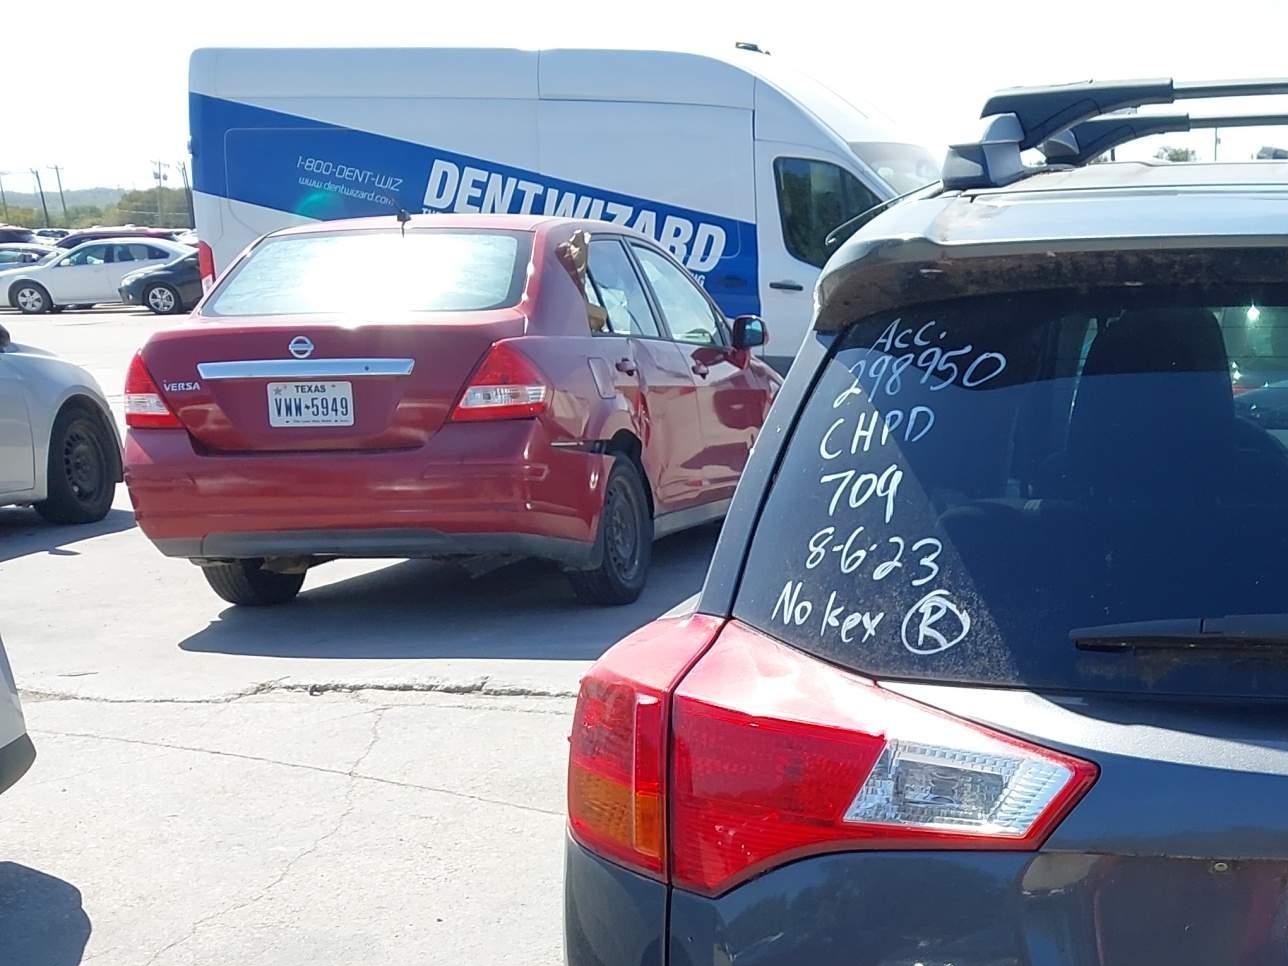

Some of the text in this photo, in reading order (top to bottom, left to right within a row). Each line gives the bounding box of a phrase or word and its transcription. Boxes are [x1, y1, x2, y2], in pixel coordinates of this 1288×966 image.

[296, 156, 403, 192] 1-800-DENT-WIZ
[298, 177, 395, 207] www.dentwizard.com
[163, 382, 200, 391] VERSA
[295, 384, 326, 393] TEXAS
[833, 345, 1007, 409] 298950
[819, 406, 935, 460] CHPD
[820, 464, 903, 523] 709
[771, 580, 812, 626] No
